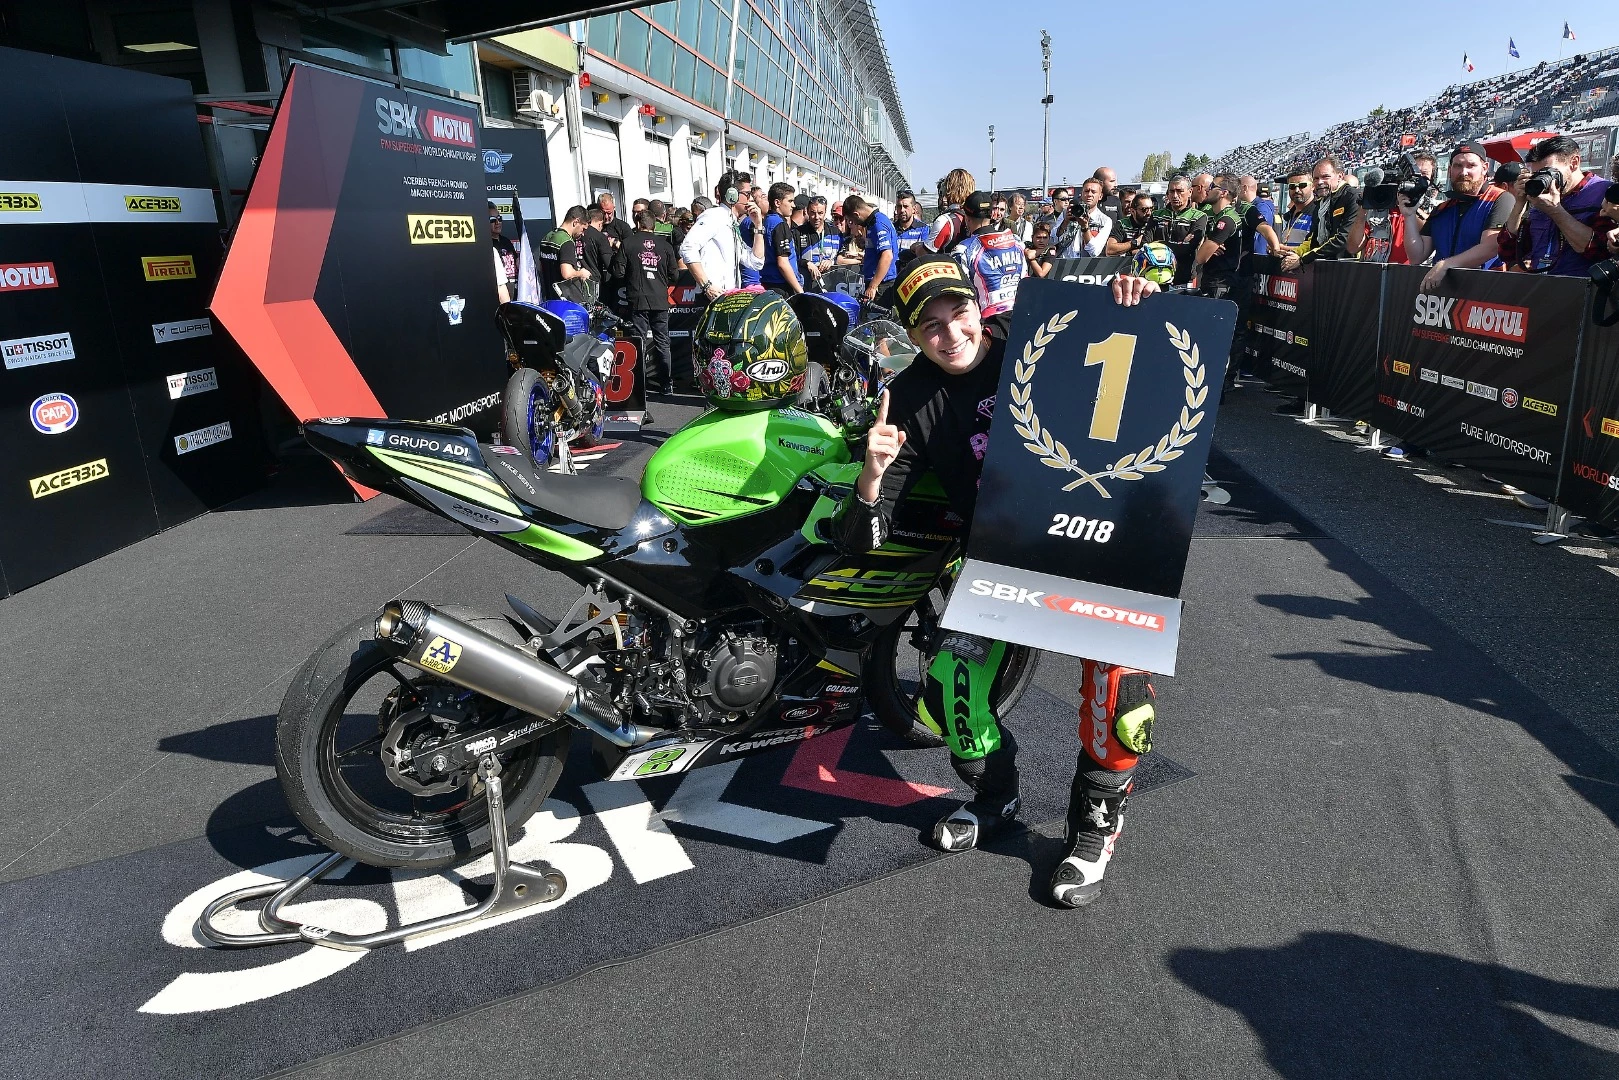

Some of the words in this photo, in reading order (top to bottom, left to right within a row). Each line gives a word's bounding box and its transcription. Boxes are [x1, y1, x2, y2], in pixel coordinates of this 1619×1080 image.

[376, 97, 422, 139] SBK
[433, 115, 473, 144] MOTUL
[410, 187, 452, 199] MAGNY-COURS
[428, 178, 450, 189] FRENCH
[147, 260, 193, 277] PIRELLI
[901, 264, 957, 298] PIRELLI
[1413, 293, 1454, 329] SBK
[1467, 305, 1524, 337] MOTUL
[170, 322, 210, 336] CUPRA
[23, 337, 69, 353] TISSOT
[1450, 335, 1472, 349] WORLD
[1472, 339, 1524, 359] CHAMPIONSHIP
[183, 371, 214, 386] TISSOT
[752, 362, 786, 376] Arai
[1084, 332, 1138, 443] 1
[40, 405, 68, 423] PATA
[1461, 422, 1483, 438] PURE
[389, 435, 440, 451] GRUPO
[442, 443, 469, 457] ADI
[778, 437, 826, 456] Kawasaki
[1048, 513, 1115, 543] 2018
[968, 578, 1046, 608] SBK
[1069, 601, 1160, 629] MOTUL
[421, 657, 451, 673] ARROW
[826, 684, 859, 694] GOLDCAR
[720, 725, 832, 755] Kawasaki
